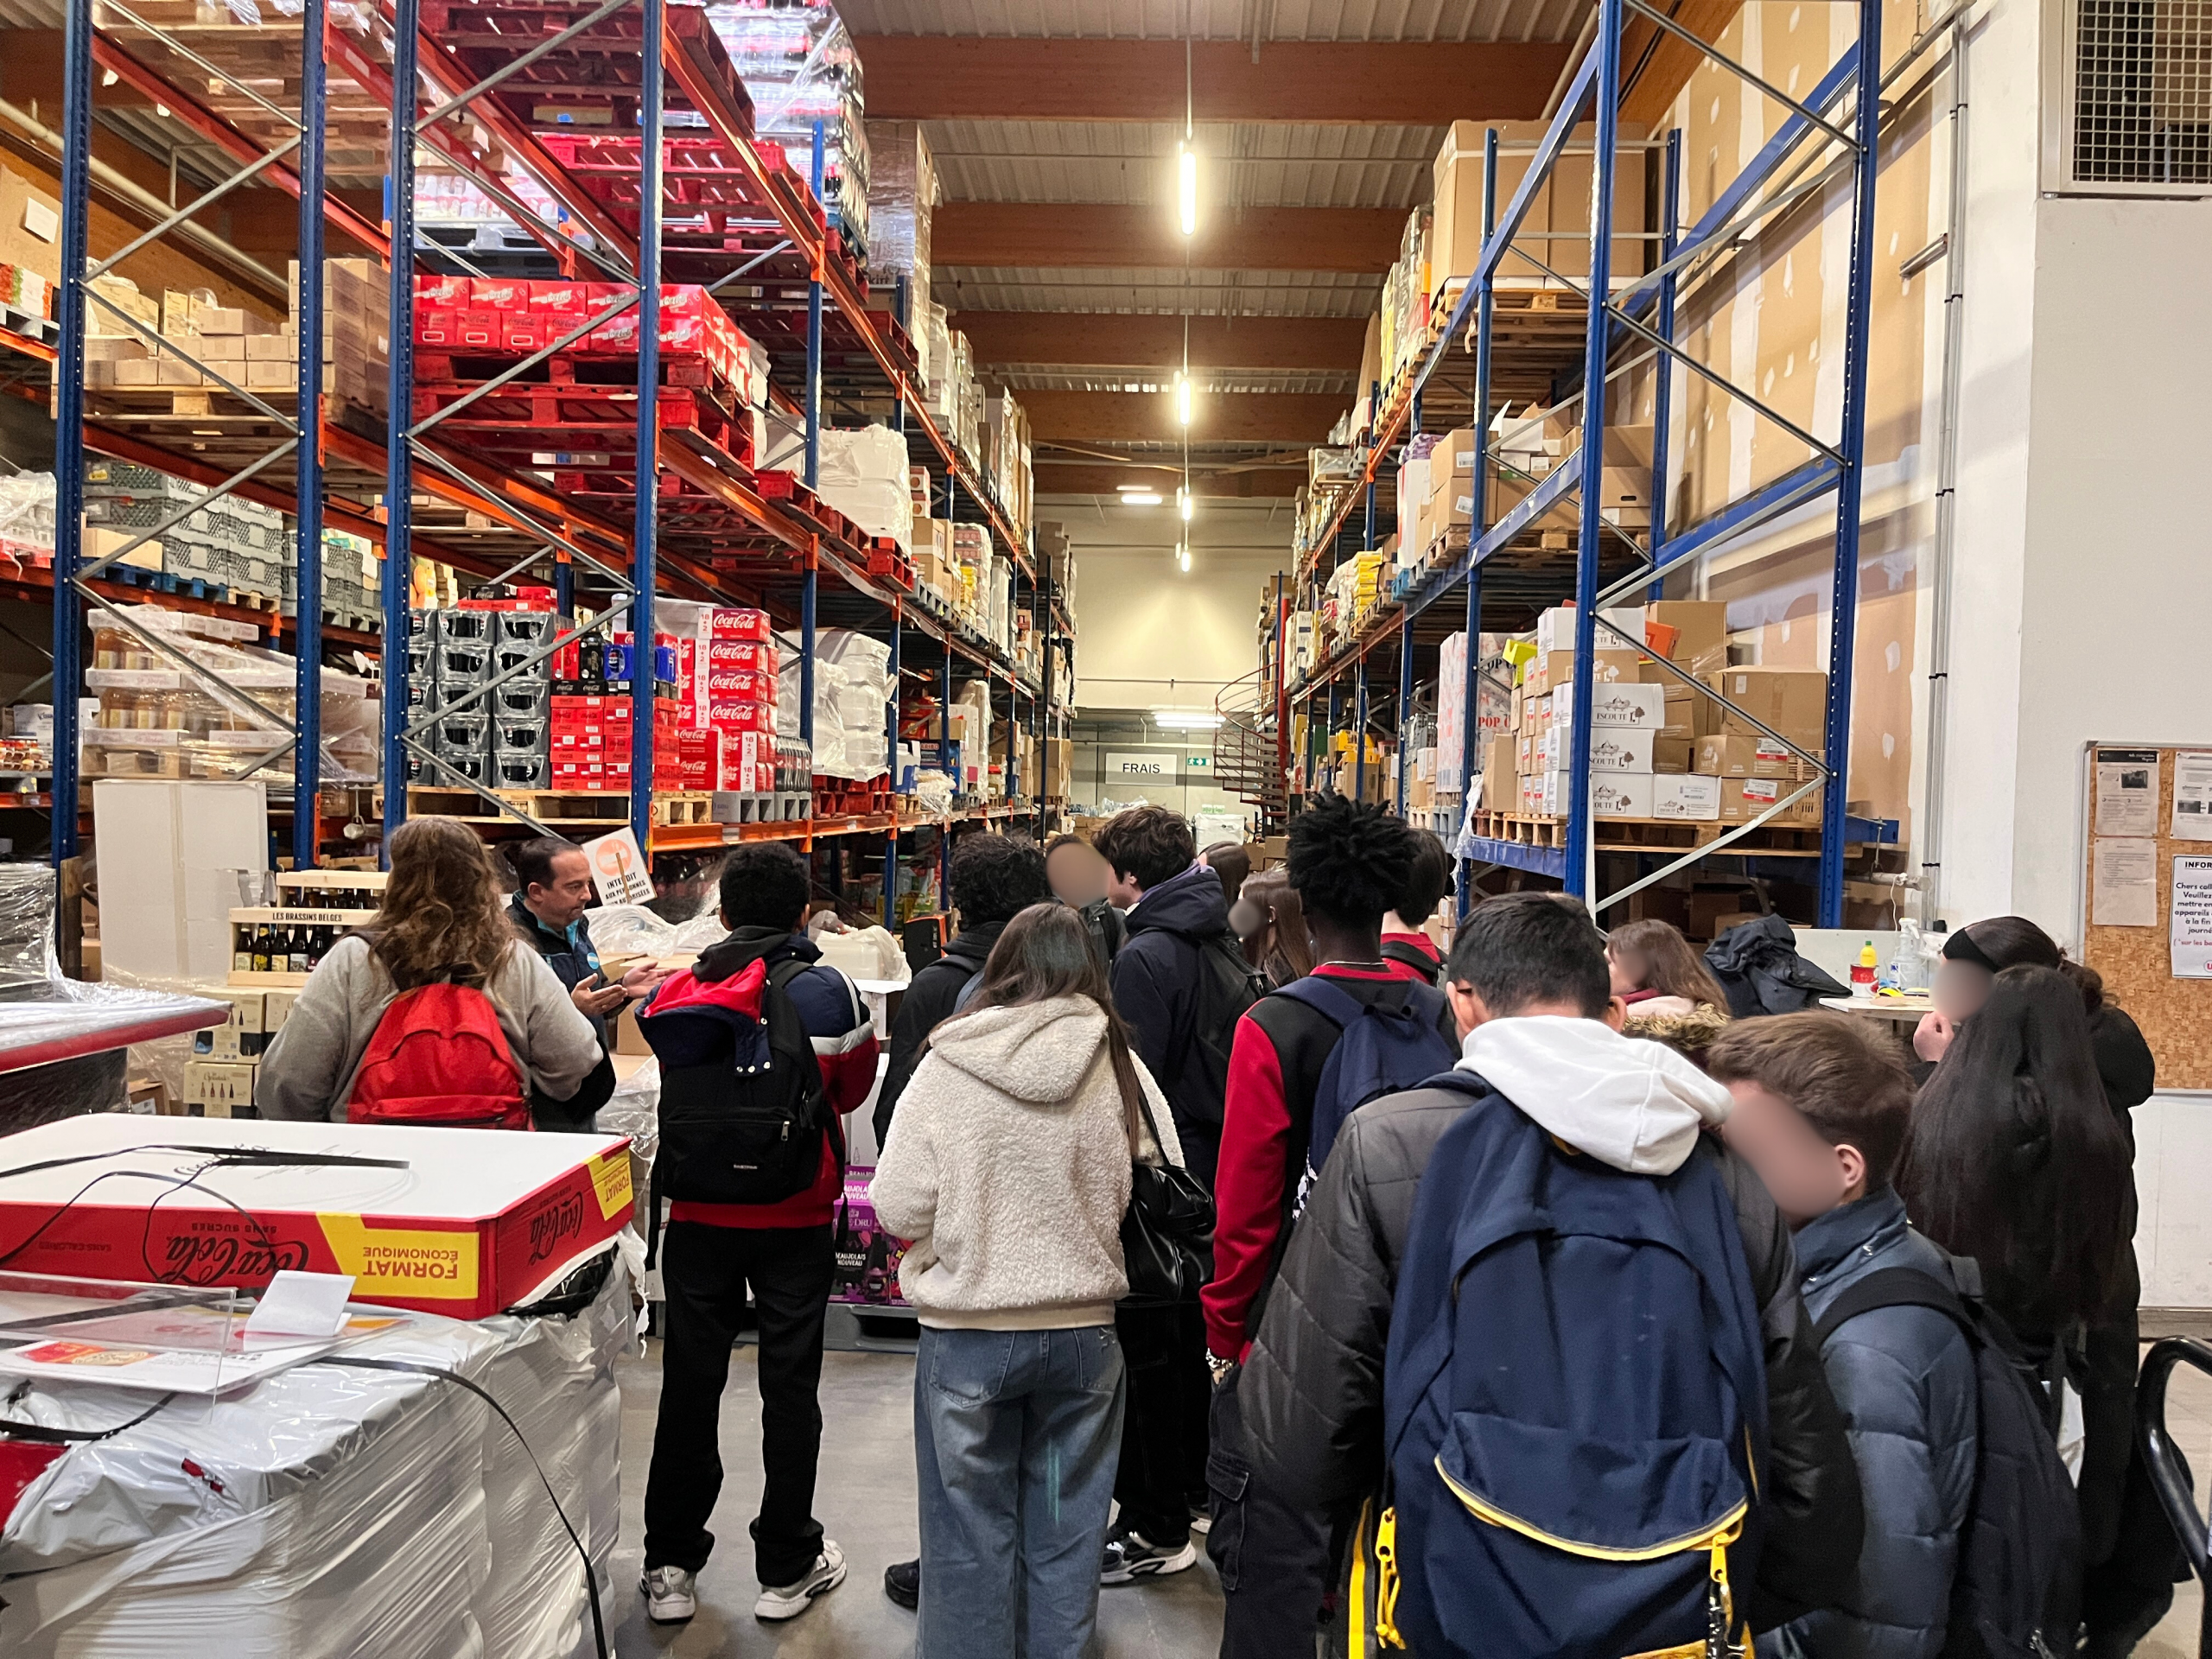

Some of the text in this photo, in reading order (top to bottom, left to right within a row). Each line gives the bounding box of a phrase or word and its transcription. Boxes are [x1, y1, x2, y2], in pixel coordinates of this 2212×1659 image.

[1478, 716, 1501, 728] POP
[1122, 763, 1160, 774] FRAIS
[1590, 757, 1616, 766] SCOUTE
[607, 872, 637, 889] INTEDIT
[616, 880, 646, 895] PERONNES
[619, 887, 651, 904] AURISÉES
[606, 1173, 629, 1202] FORMAT
[192, 1223, 239, 1232] SUCRES
[363, 1247, 458, 1262] ÉCONOMIQUE
[363, 1261, 457, 1279] FORMAT
